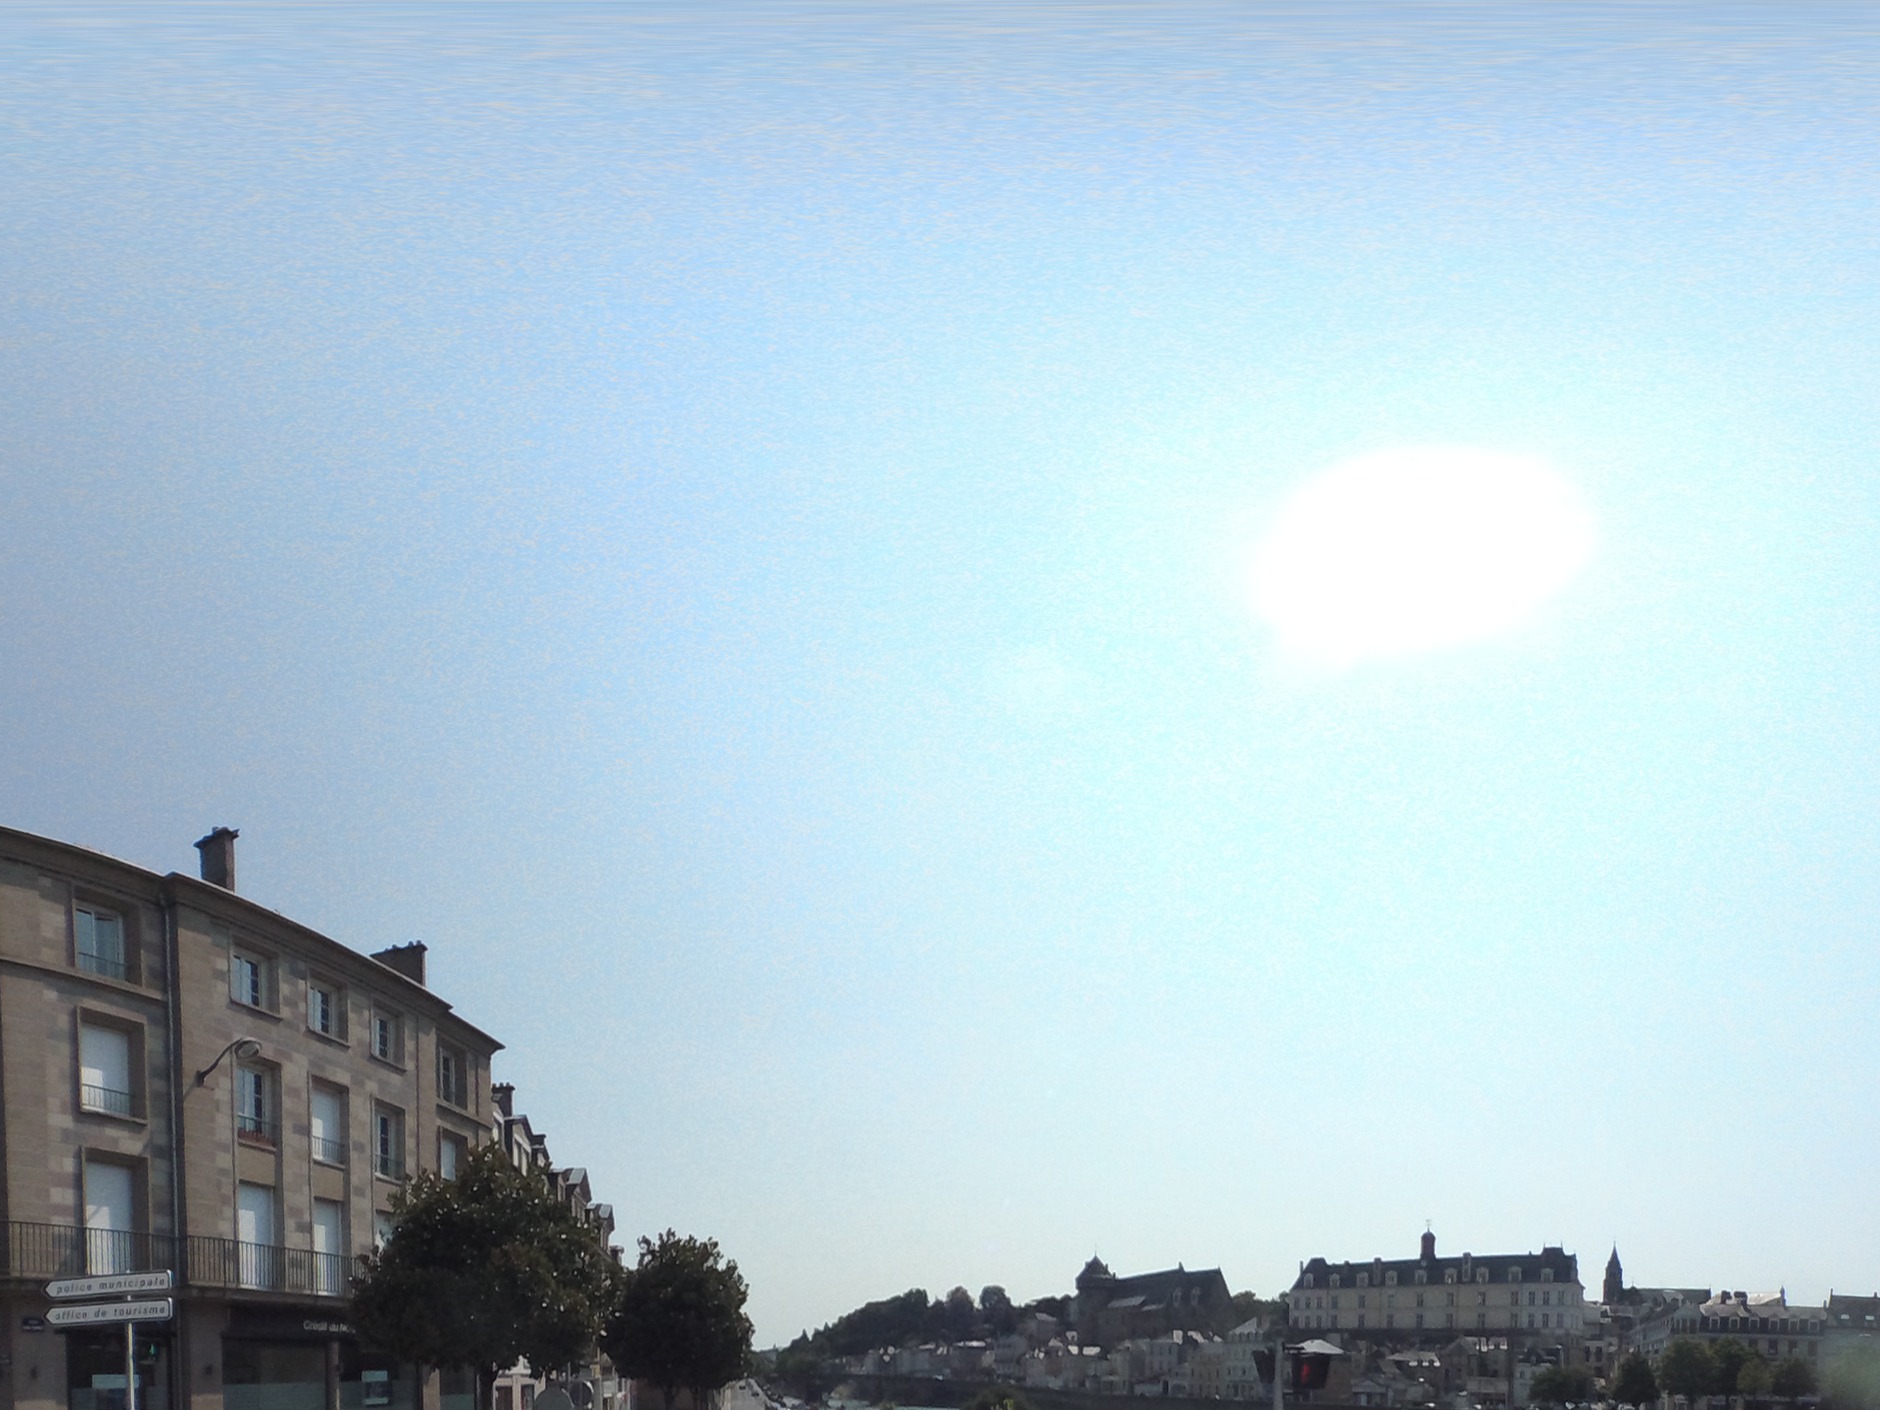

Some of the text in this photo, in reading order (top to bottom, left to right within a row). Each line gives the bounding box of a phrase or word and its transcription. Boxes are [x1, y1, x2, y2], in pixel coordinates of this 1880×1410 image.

[56, 1277, 165, 1295] police municipale
[55, 1305, 166, 1320] office de tourisme
